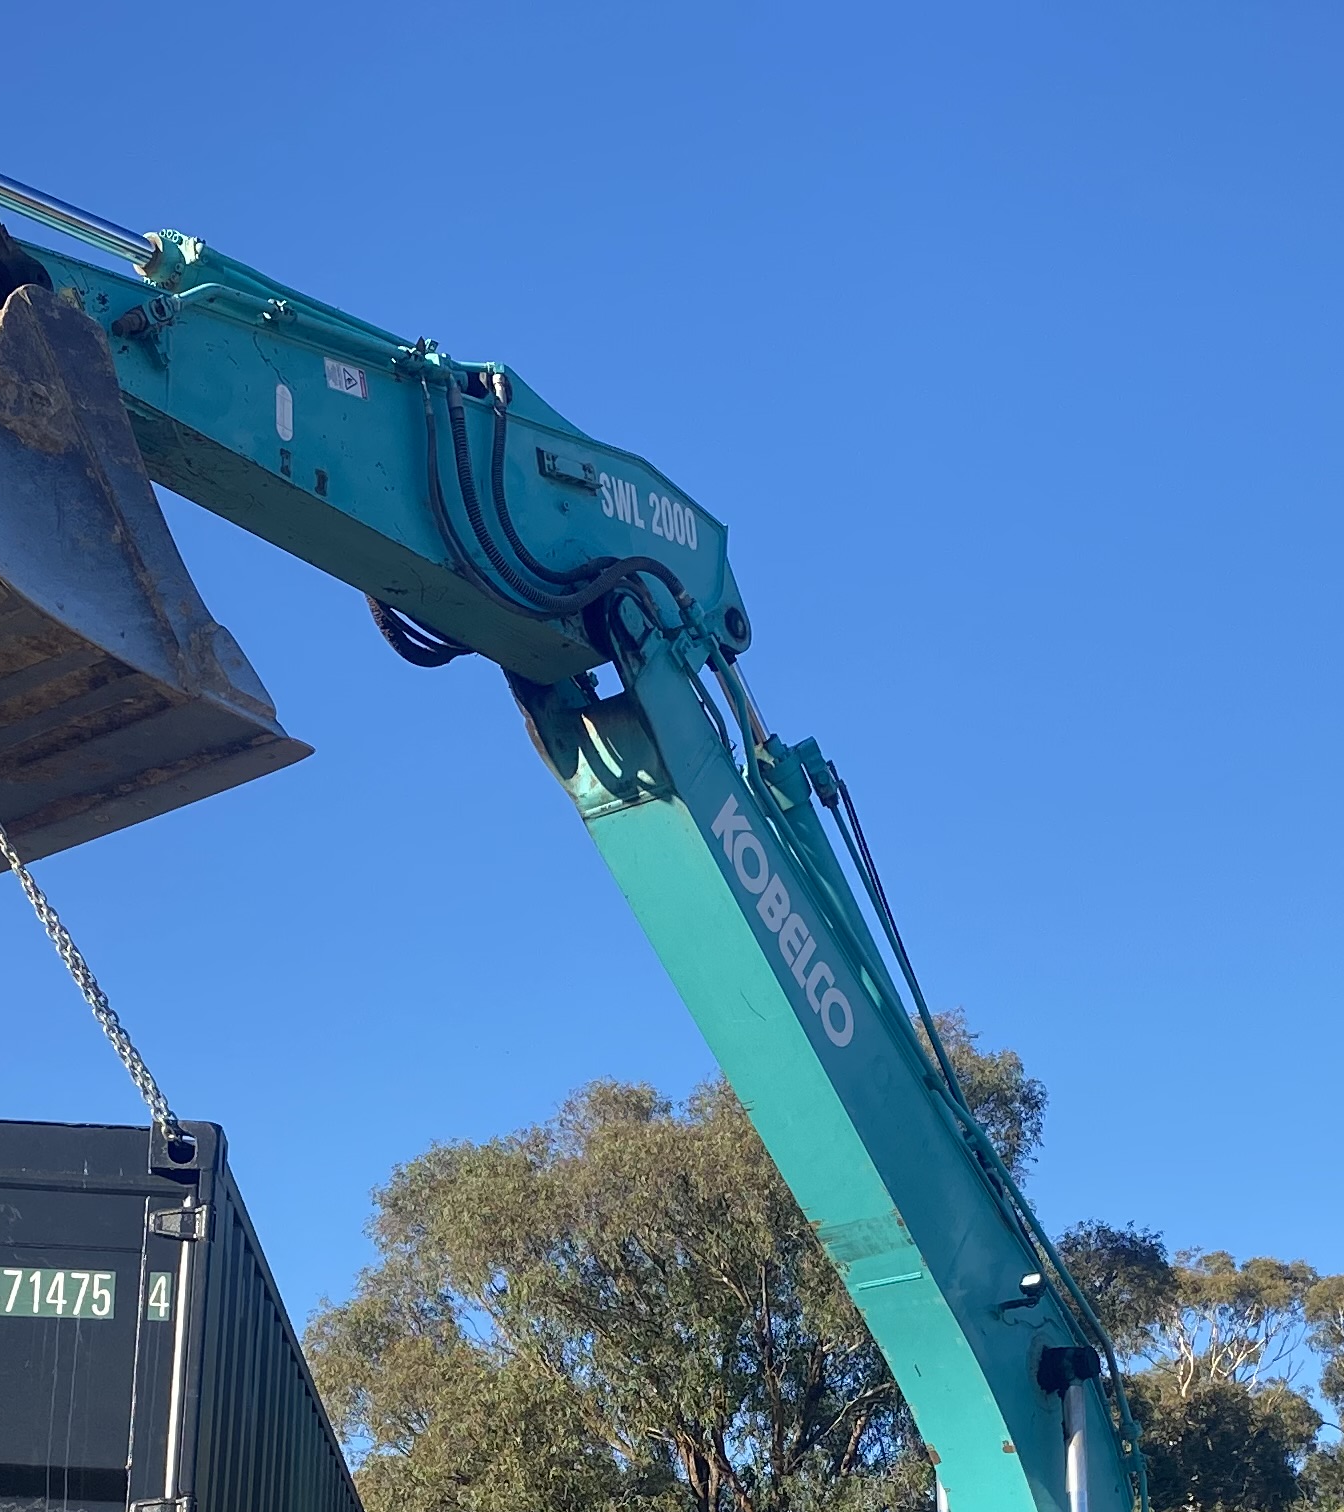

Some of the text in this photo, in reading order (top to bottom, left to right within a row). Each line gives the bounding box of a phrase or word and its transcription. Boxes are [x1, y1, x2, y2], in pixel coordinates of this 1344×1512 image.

[598, 471, 699, 551] SWL 2000
[710, 793, 855, 1048] KOBELCO
[148, 1275, 170, 1318] 4
